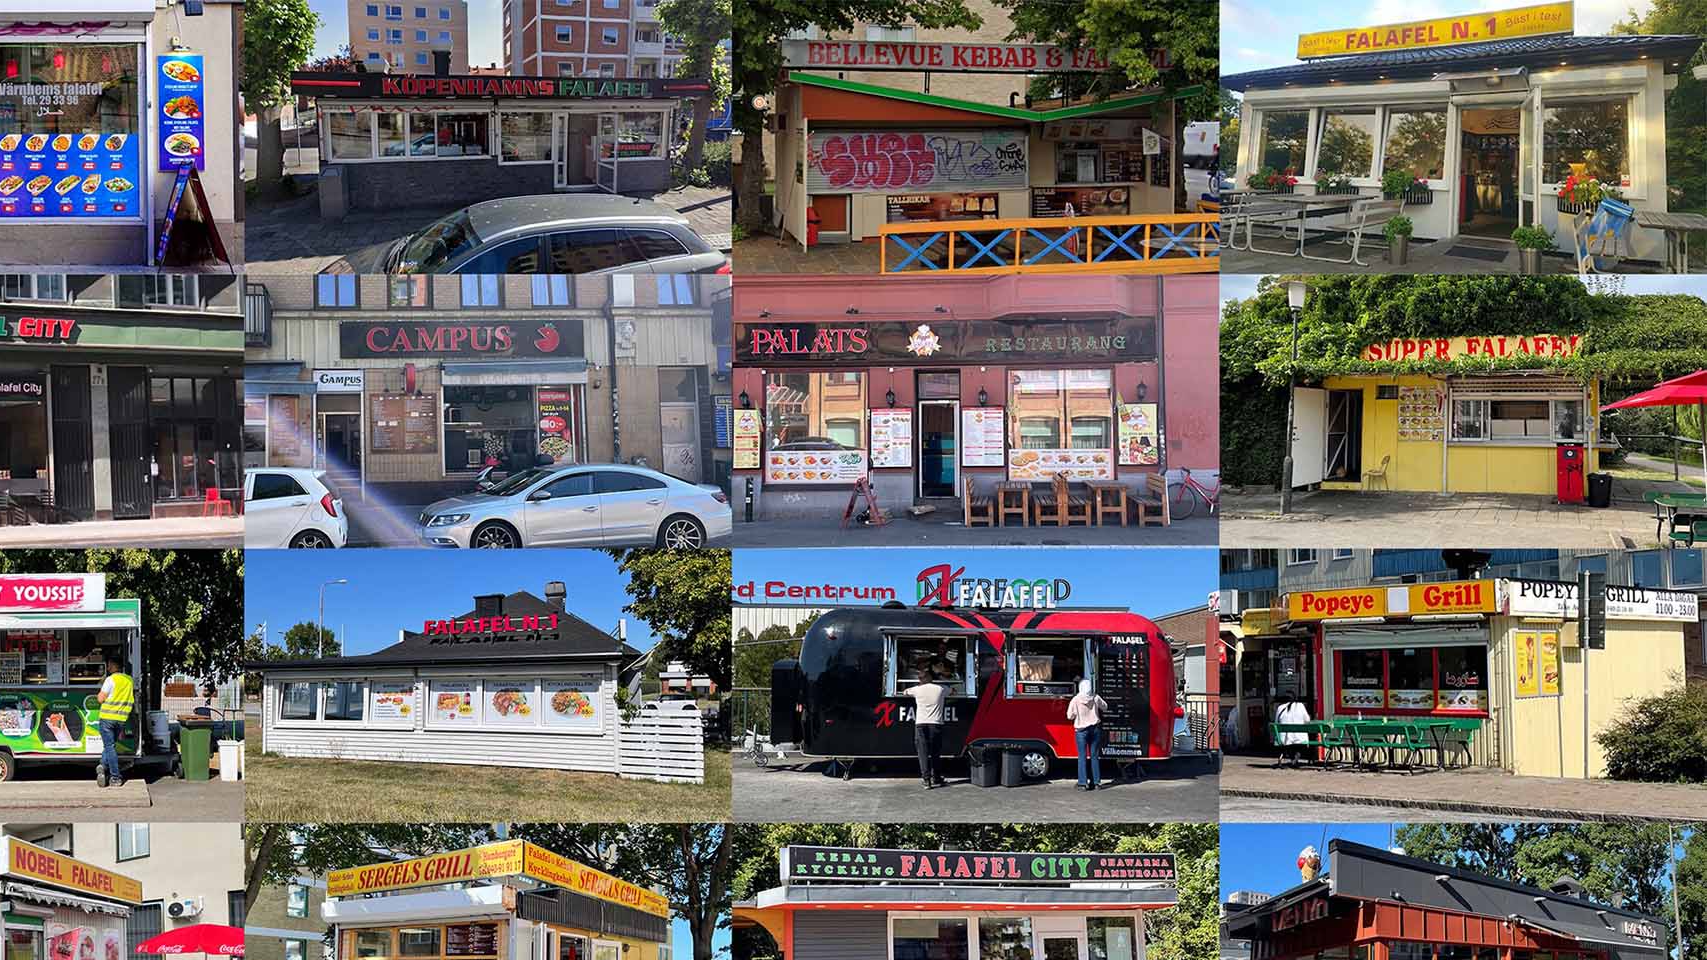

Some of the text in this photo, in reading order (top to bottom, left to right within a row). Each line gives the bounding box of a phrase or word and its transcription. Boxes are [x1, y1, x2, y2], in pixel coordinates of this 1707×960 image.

[1345, 26, 1440, 50] FALAFEL
[807, 42, 1063, 68] BELLEVUE KEBAB &
[63, 83, 103, 96] falafel
[382, 73, 651, 97] KÖPENHAMNS FALAFEL
[18, 317, 76, 339] CITY
[365, 325, 513, 353] CAMPUS
[750, 328, 869, 354] PALATS
[985, 336, 1127, 353] RESTAURANG
[1369, 337, 1451, 361] SUPER
[23, 381, 42, 395] City
[13, 585, 84, 601] YOUSSIF
[765, 581, 895, 599] Centrum
[959, 583, 1057, 609] FALAFEL
[1423, 583, 1482, 608] Grill
[1606, 586, 1650, 604] GRILL
[1301, 592, 1375, 618] Popeye
[424, 616, 516, 637] FALAFEL
[1101, 746, 1143, 757] Välkommen
[15, 846, 63, 881] NOBEL
[71, 857, 115, 893] FALAFEL
[796, 863, 896, 877] KYCKLING
[815, 852, 878, 864] KEBAB
[900, 855, 1092, 879] FALAFEL CITY
[358, 853, 474, 890] SERGELS GRILL
[1093, 868, 1174, 879] HAMBURGARE
[578, 869, 643, 906] SERGELS GRILL
